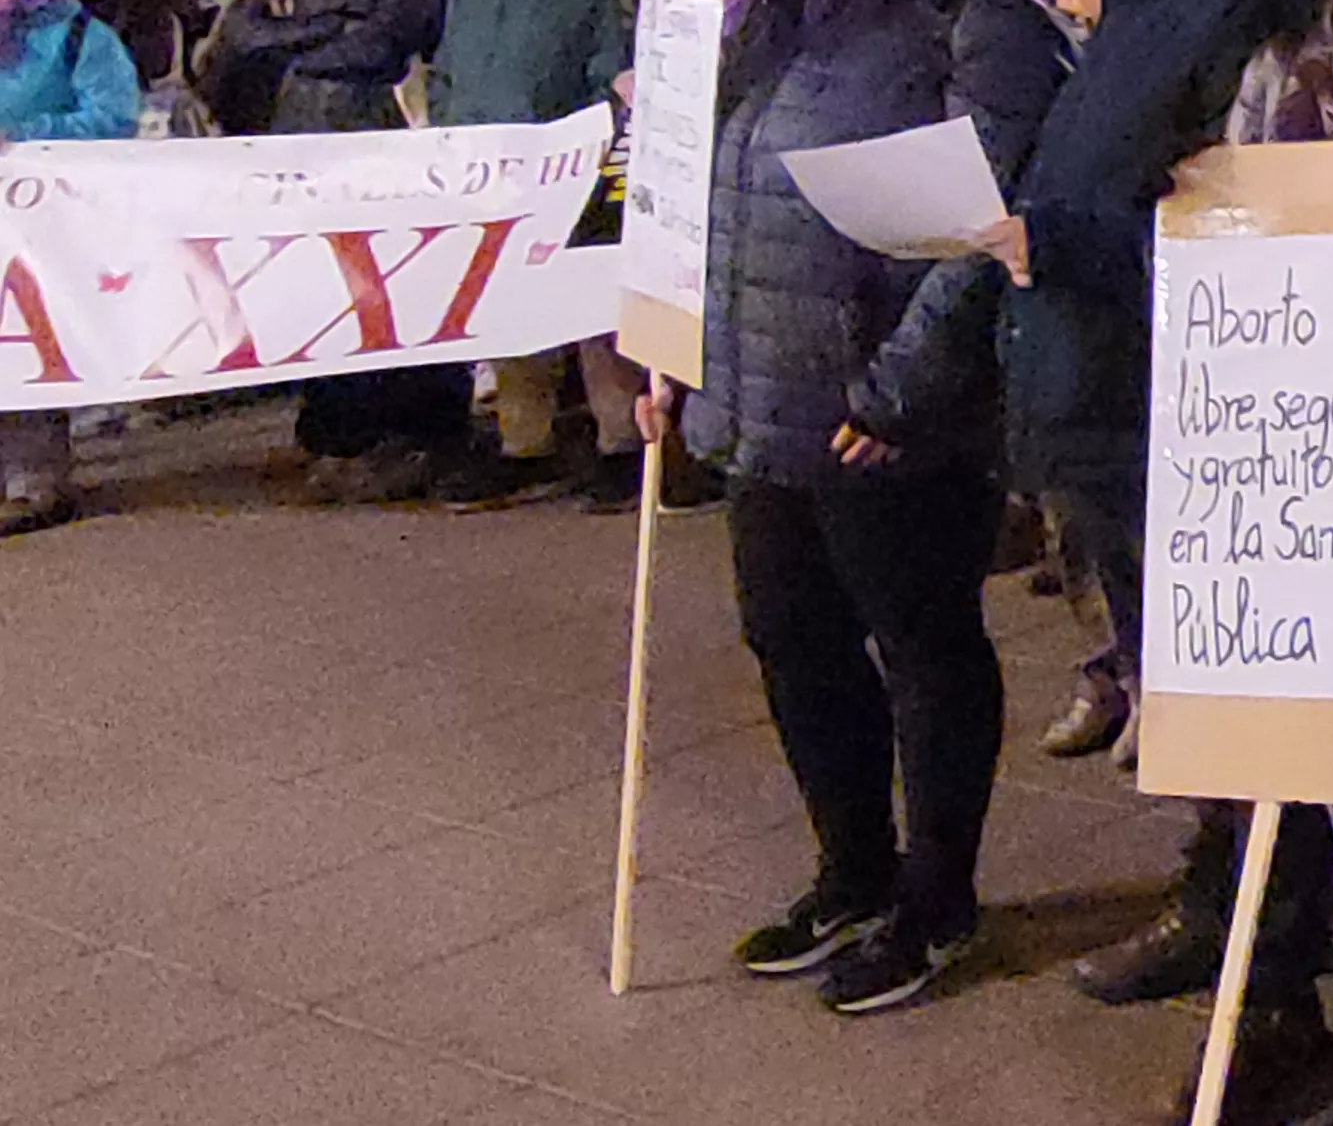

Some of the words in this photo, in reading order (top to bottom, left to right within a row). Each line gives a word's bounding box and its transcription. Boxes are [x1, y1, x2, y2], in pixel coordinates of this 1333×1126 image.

[137, 212, 533, 379] XXI
[1186, 266, 1316, 350] Aborto
[1169, 529, 1209, 564] en
[1224, 490, 1264, 564] la
[1172, 576, 1317, 667] Pública
